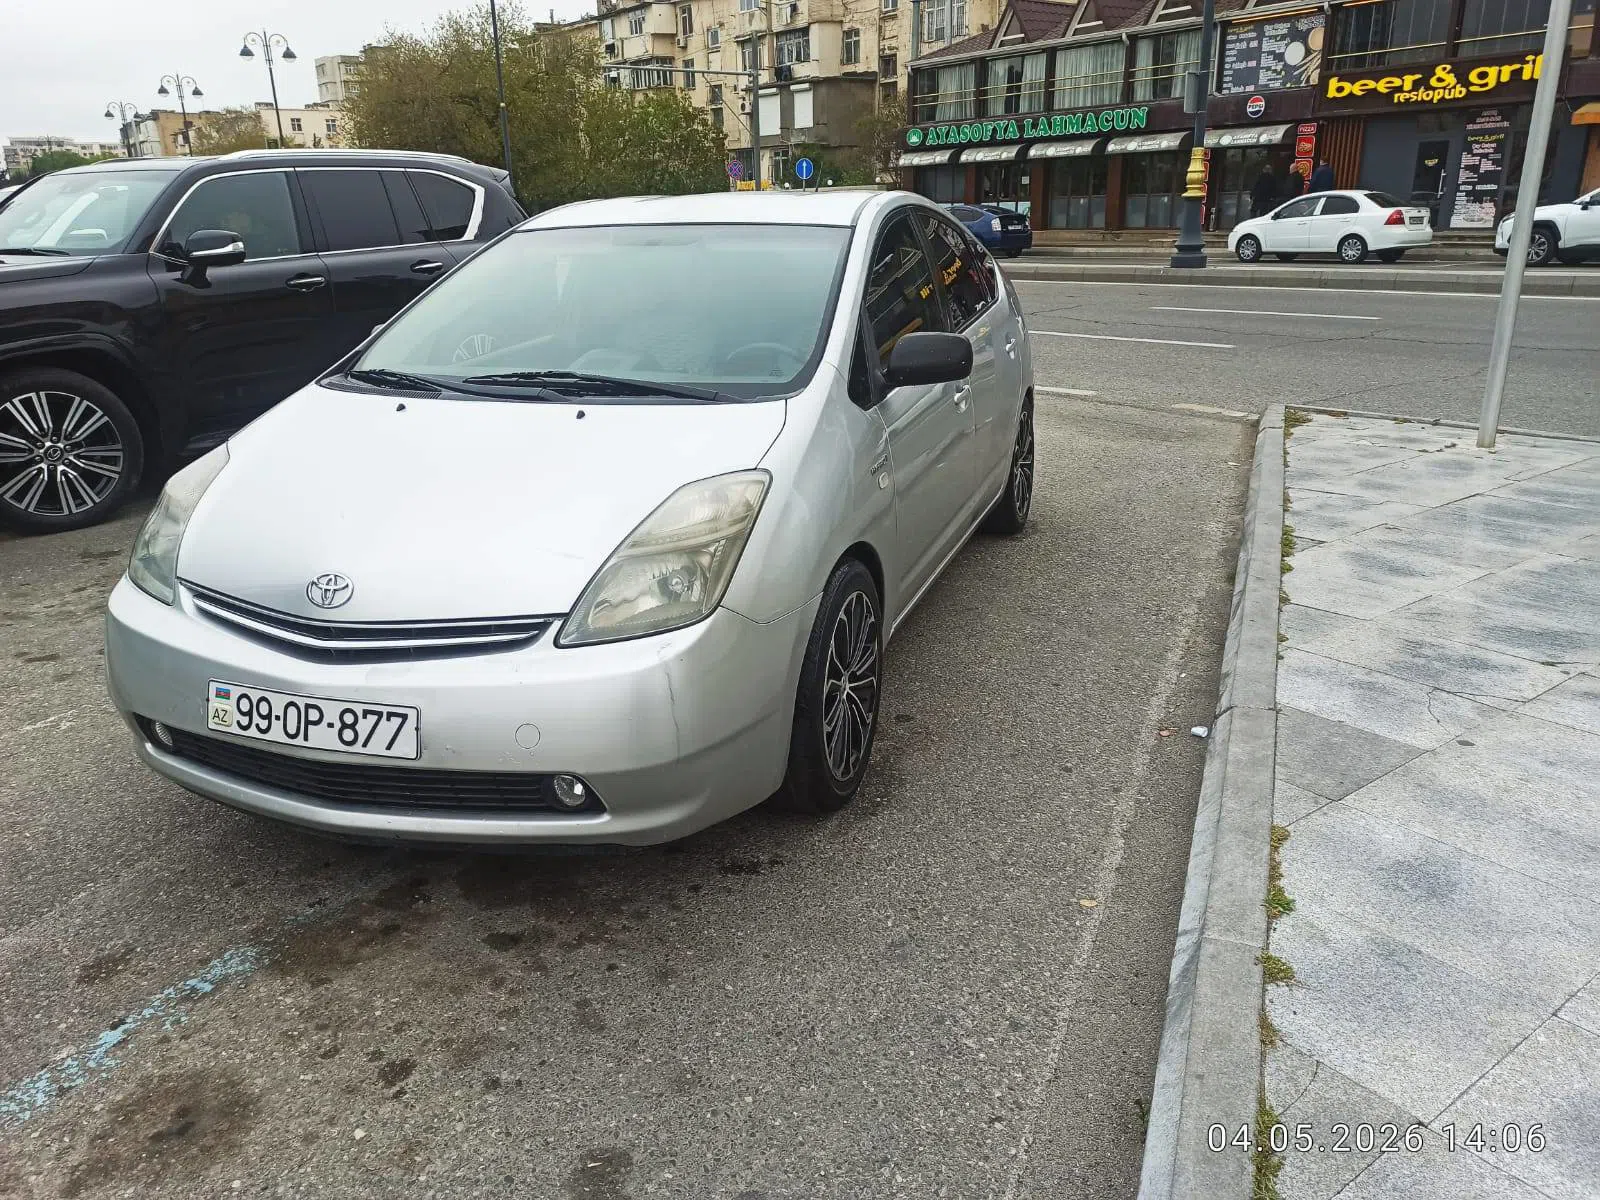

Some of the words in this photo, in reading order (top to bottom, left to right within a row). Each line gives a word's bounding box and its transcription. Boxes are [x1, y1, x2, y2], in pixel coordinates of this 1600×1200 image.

[1326, 72, 1422, 99] beer
[1429, 64, 1458, 89] &
[1468, 54, 1545, 91] gril
[1393, 84, 1467, 103] restopub
[925, 119, 1019, 146] AYASOFYA
[1023, 106, 1148, 138] LAHMACUN
[211, 708, 228, 724] AZ
[235, 692, 409, 751] 99-OP-877
